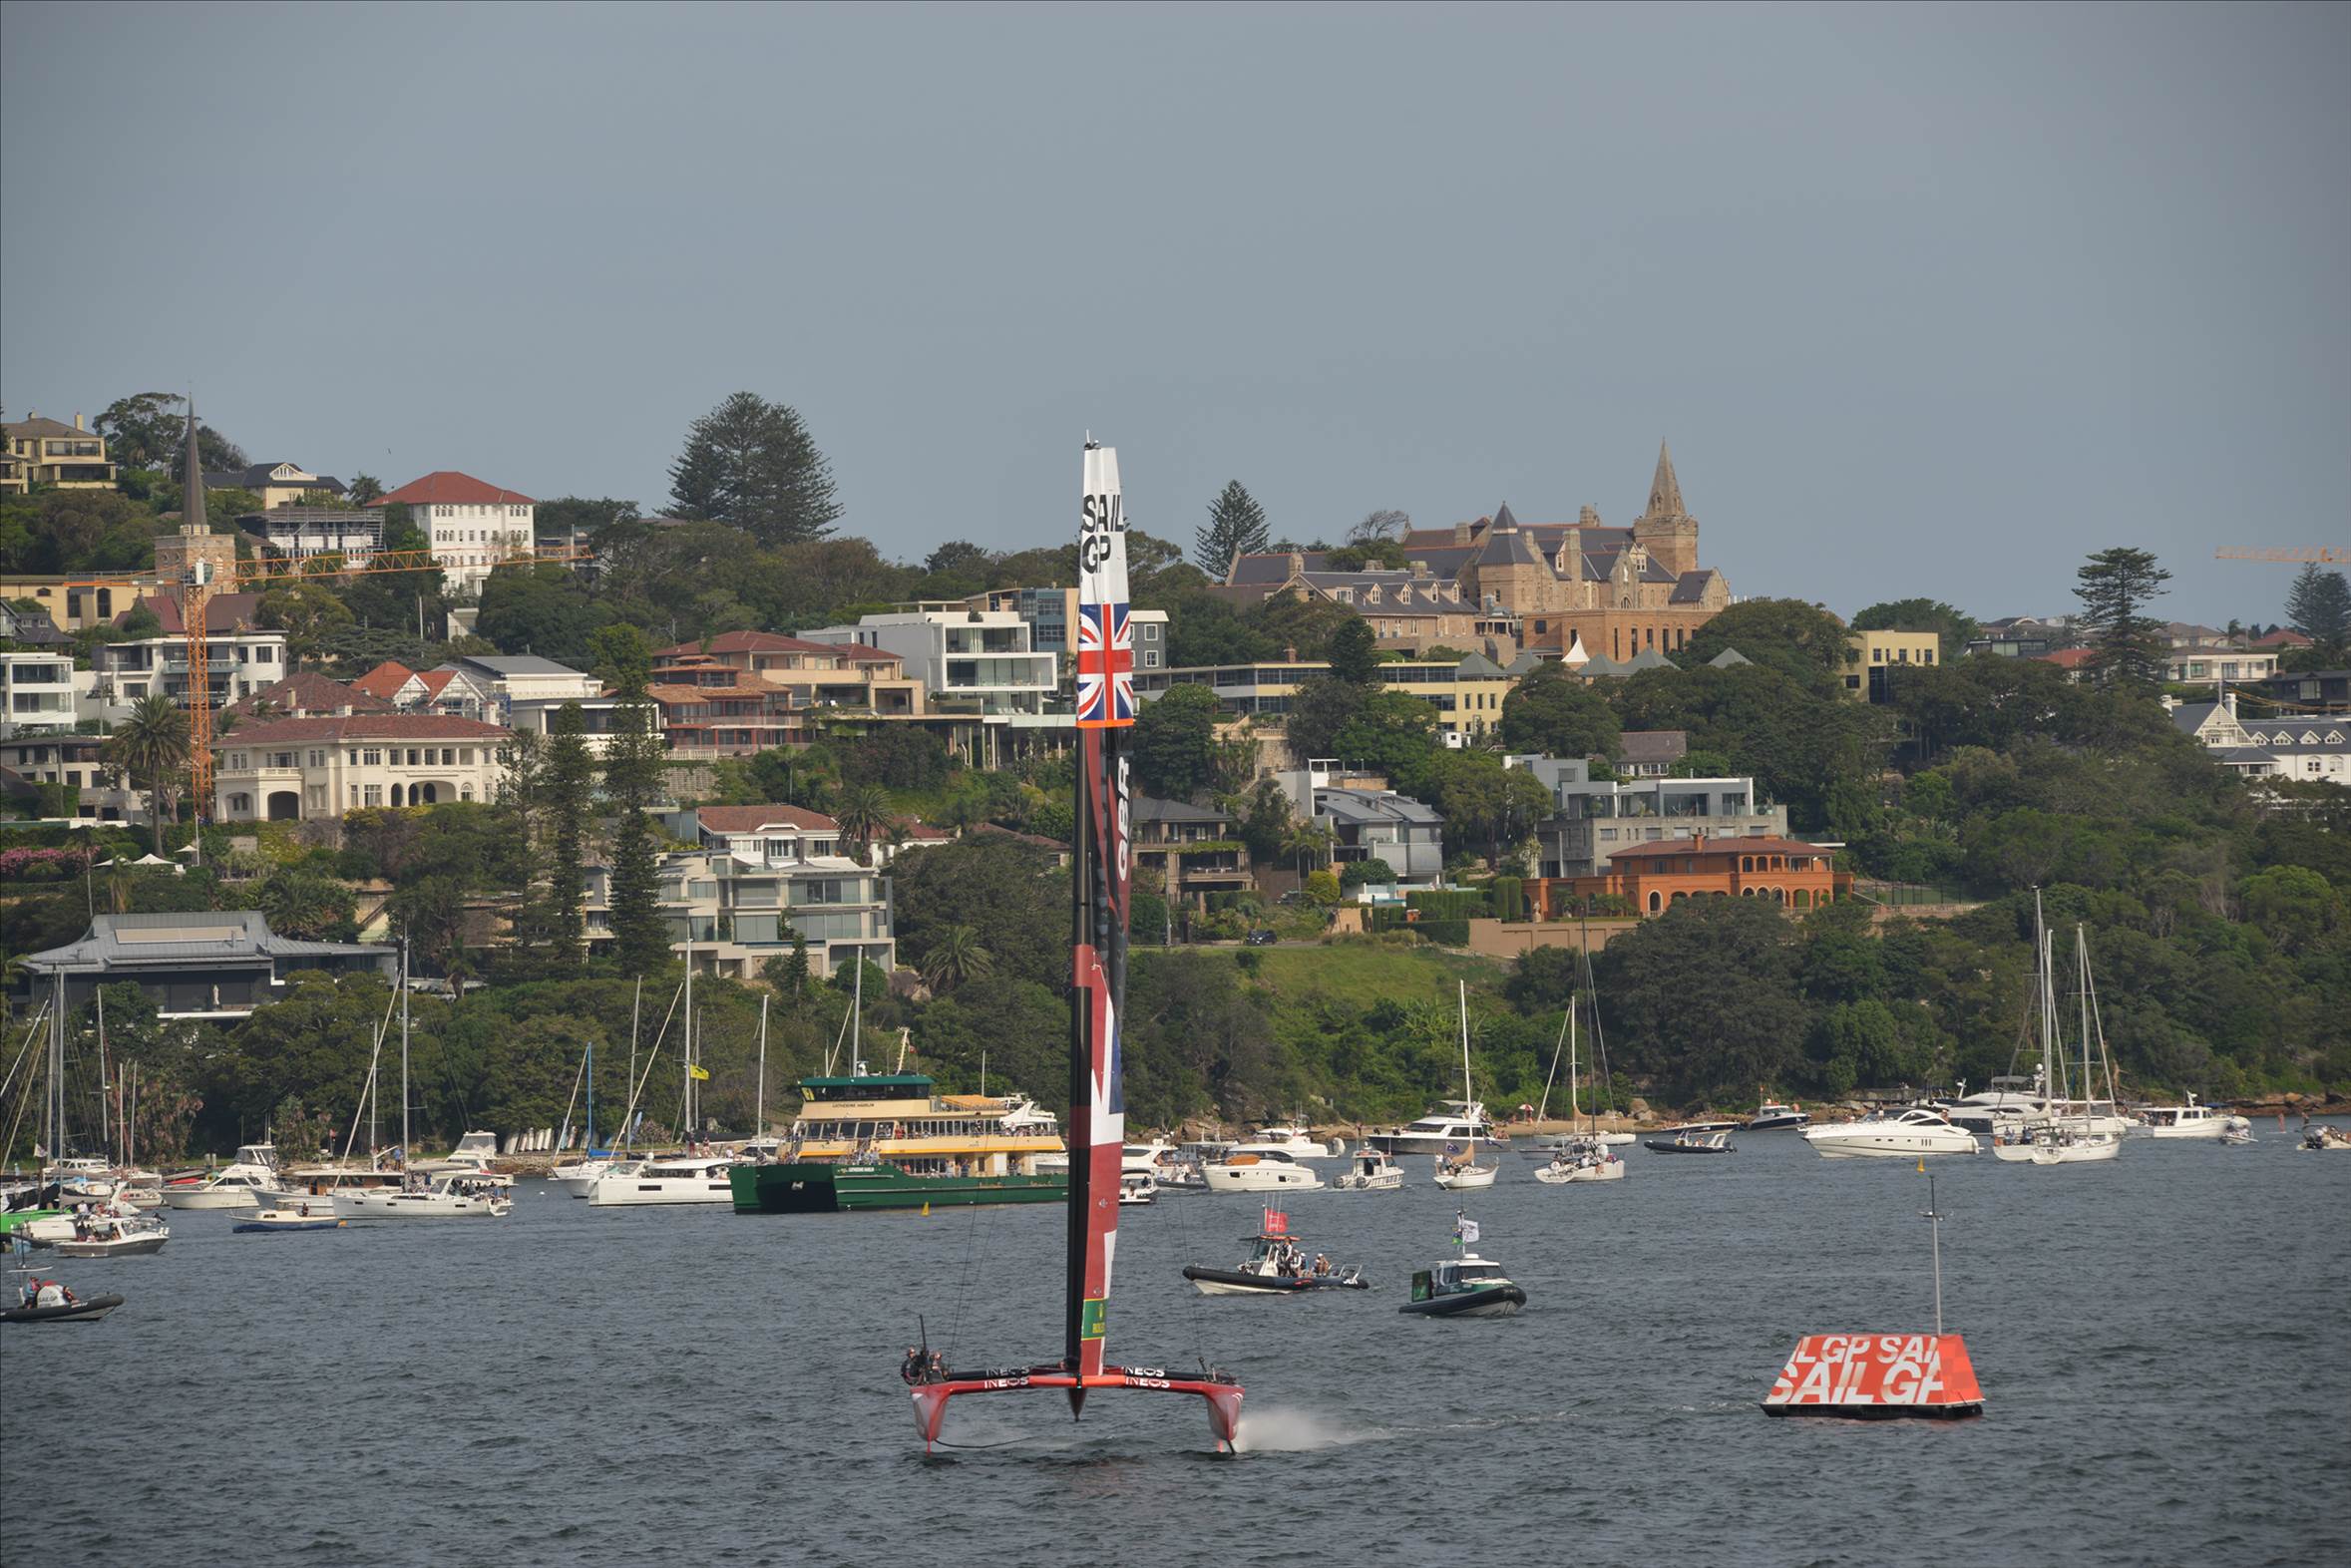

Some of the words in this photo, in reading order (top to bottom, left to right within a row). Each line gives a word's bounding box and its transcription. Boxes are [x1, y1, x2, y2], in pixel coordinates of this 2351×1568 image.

[1082, 494, 1124, 533] SAIL
[1081, 535, 1111, 574] GP
[1118, 756, 1129, 881] GBR
[1820, 1337, 1871, 1364] GP
[983, 1376, 1029, 1388] INEOS
[1125, 1376, 1170, 1388] INEOS
[1765, 1361, 1874, 1404] SAIL
